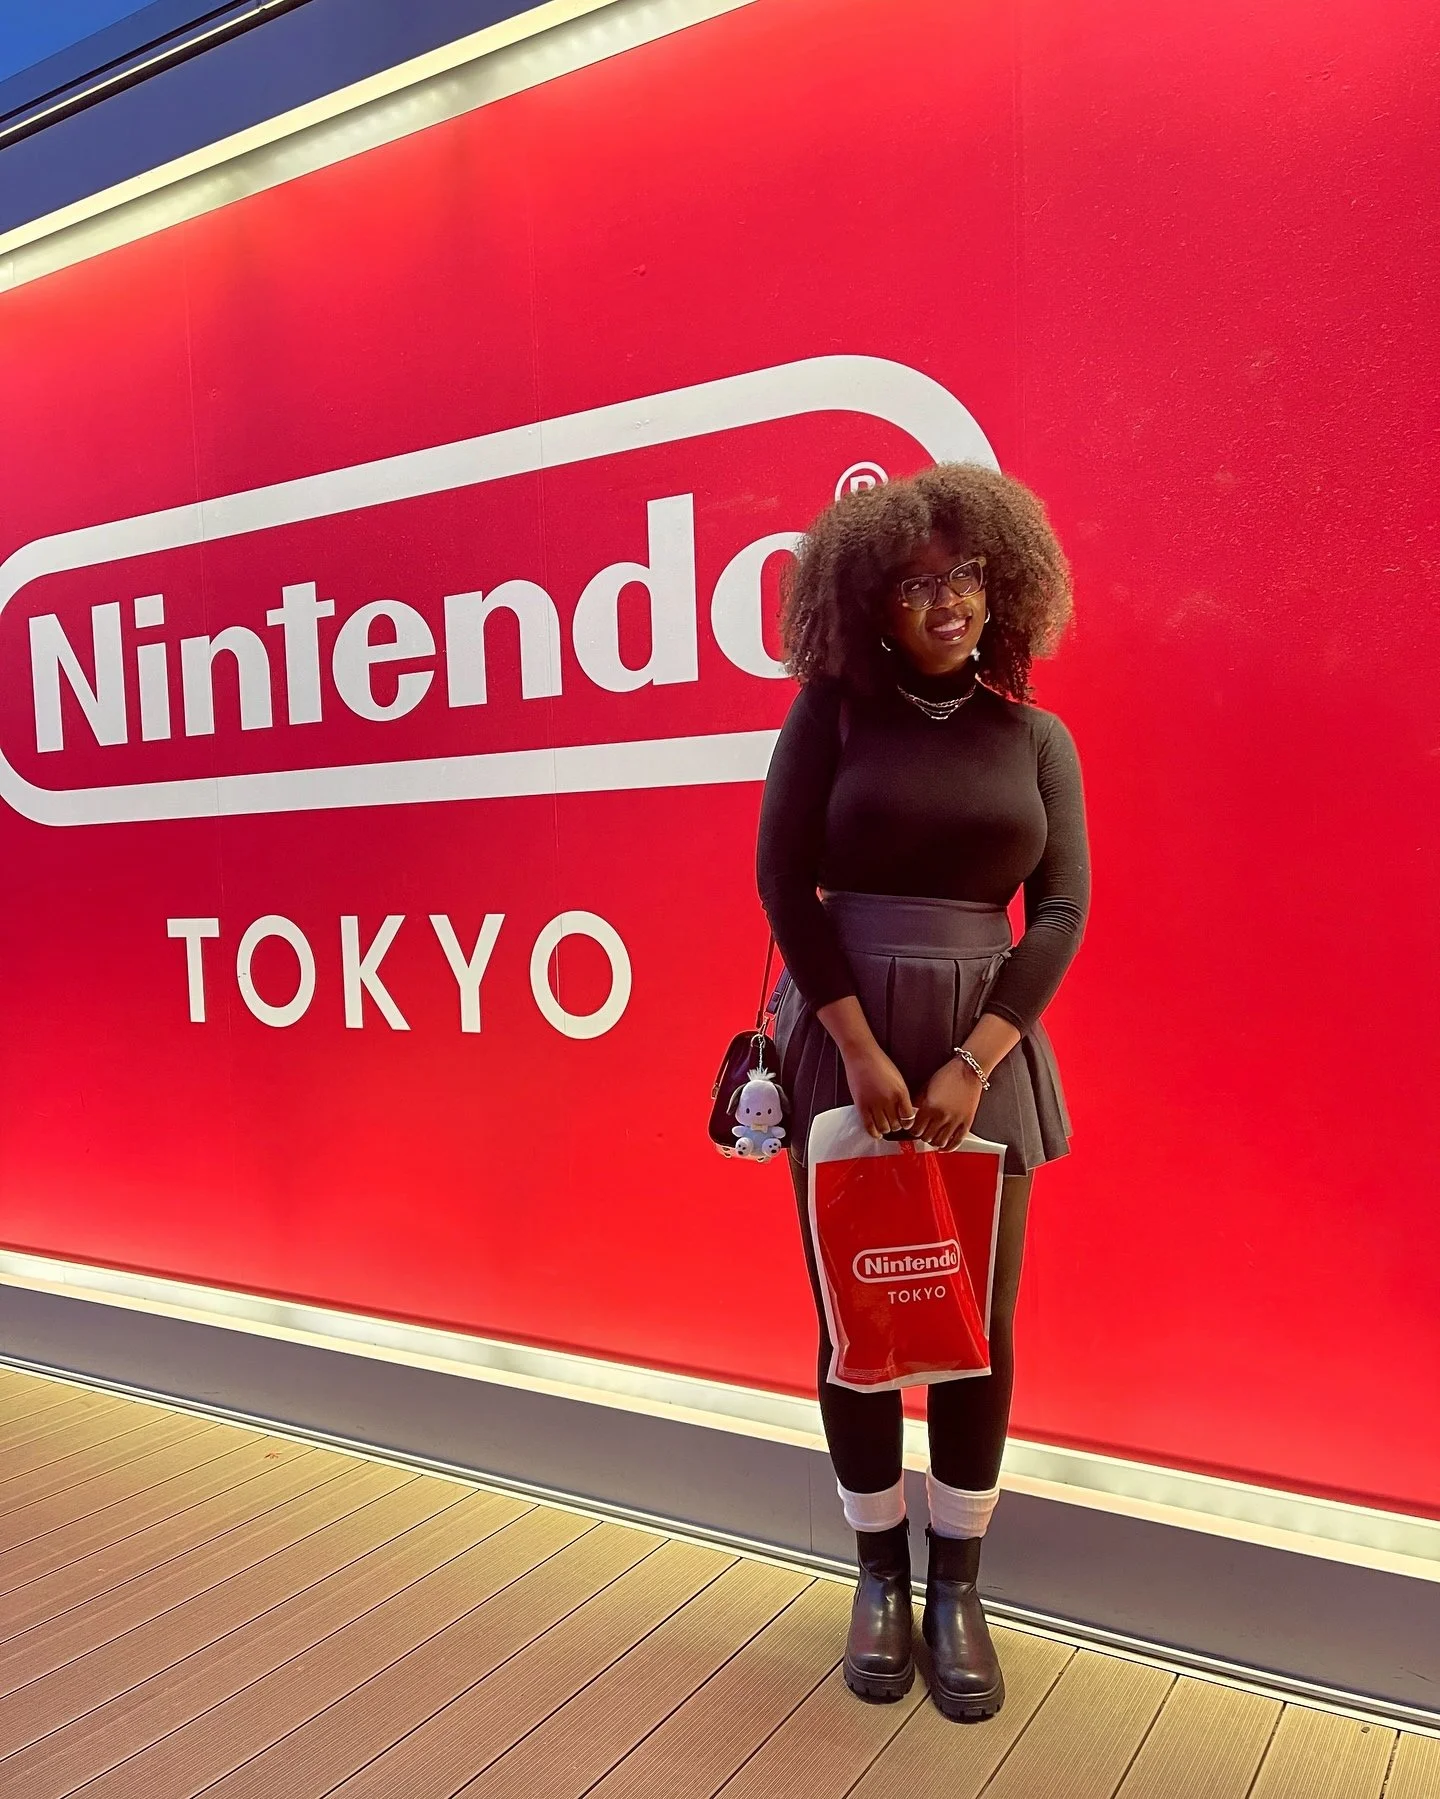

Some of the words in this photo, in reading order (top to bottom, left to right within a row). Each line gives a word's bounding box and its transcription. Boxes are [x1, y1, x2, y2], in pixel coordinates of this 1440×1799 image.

[28, 493, 805, 754] Nintendo
[167, 910, 632, 1040] TOKYO
[865, 1249, 957, 1275] Nintendo
[888, 1286, 946, 1304] TOKYO
